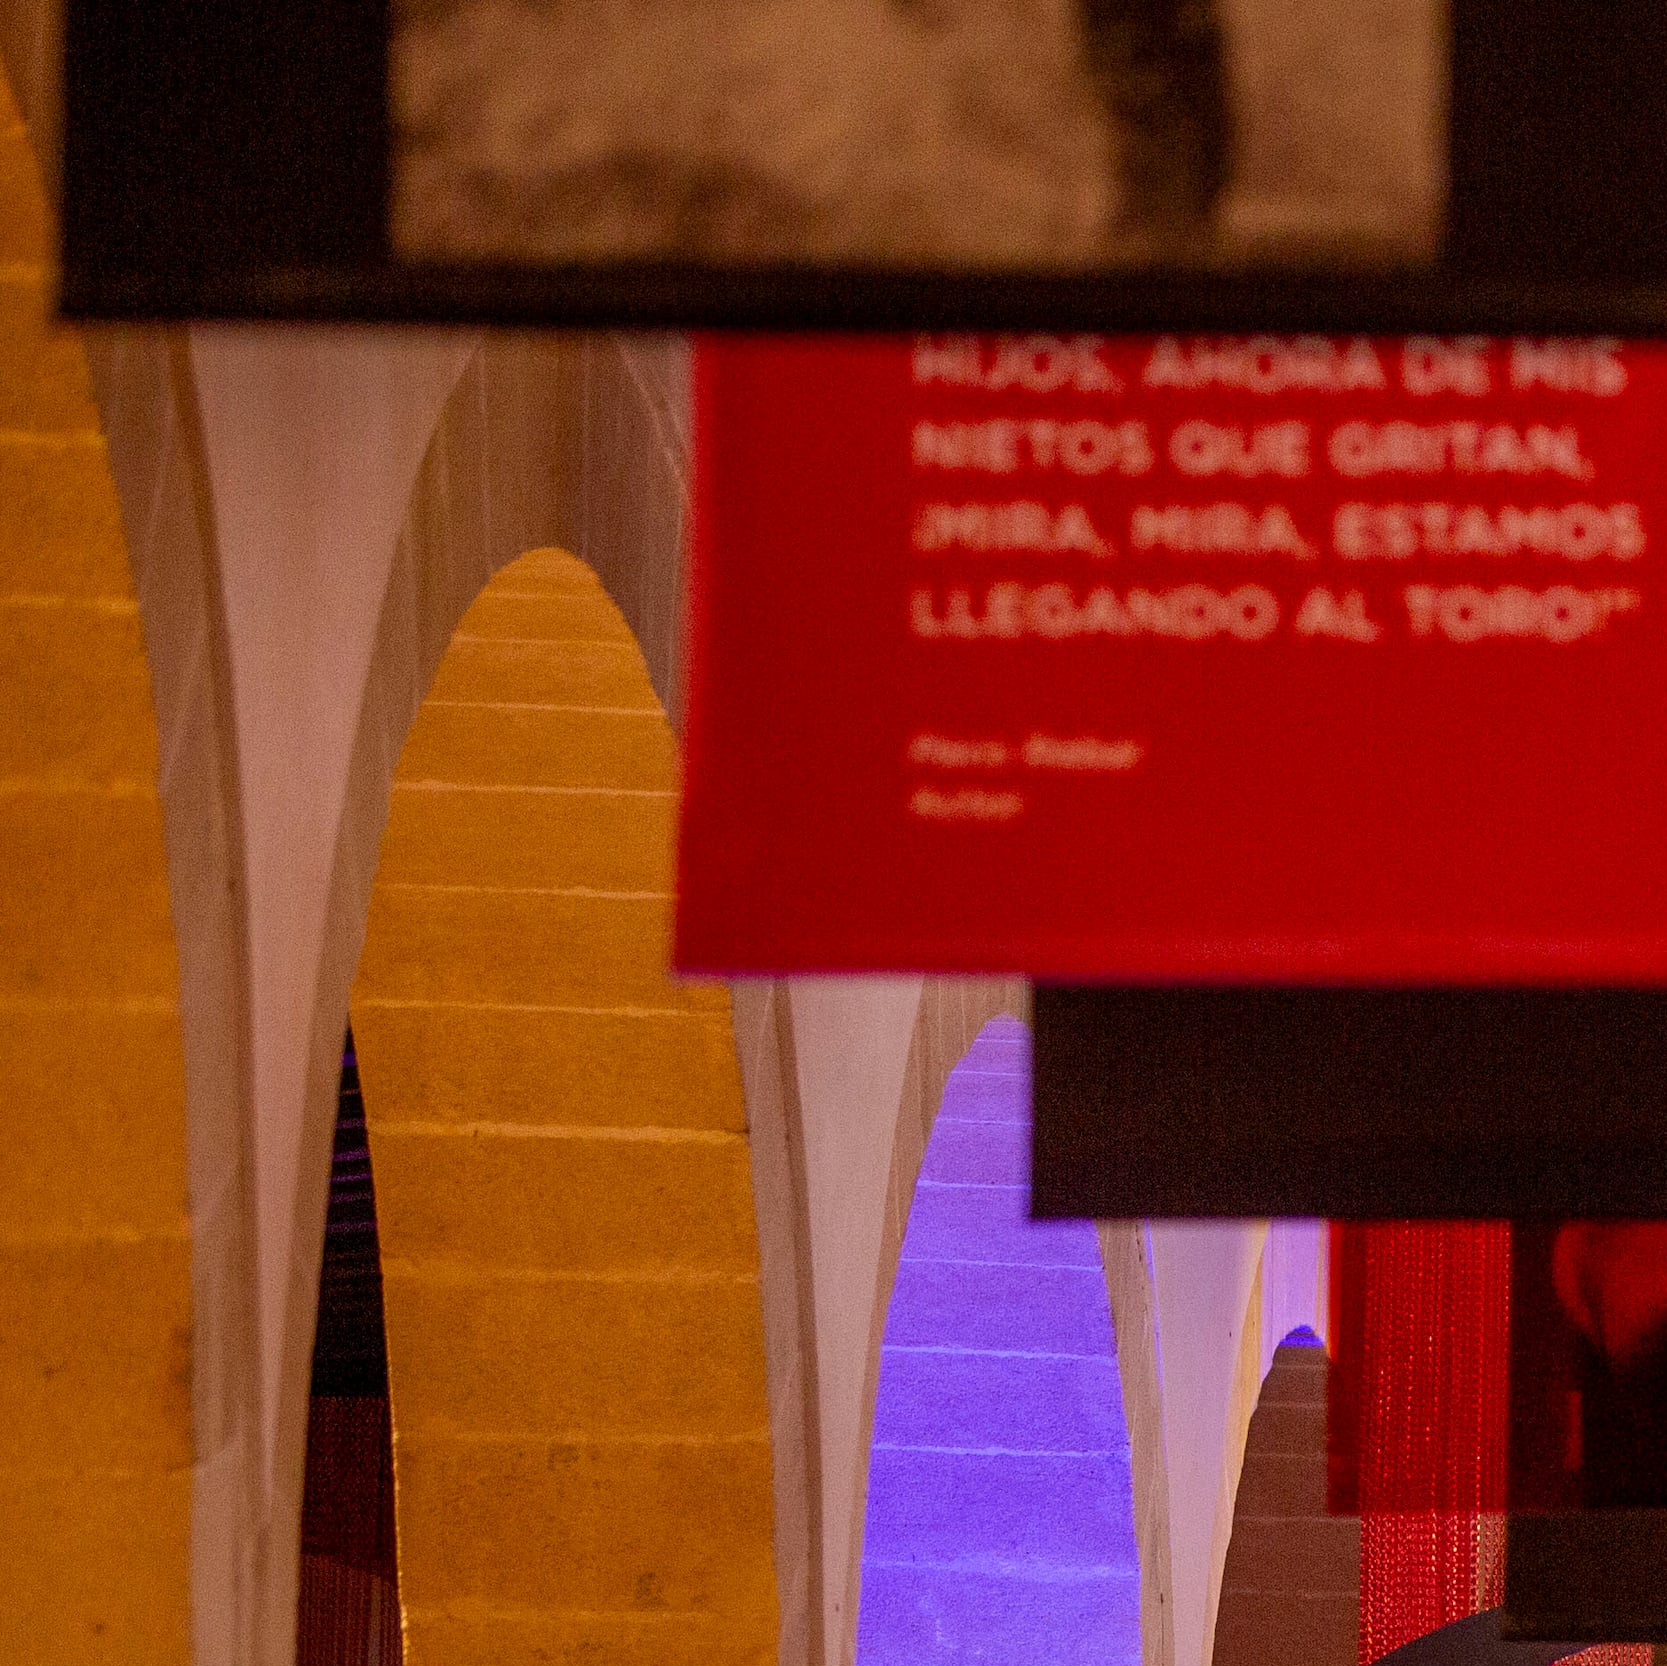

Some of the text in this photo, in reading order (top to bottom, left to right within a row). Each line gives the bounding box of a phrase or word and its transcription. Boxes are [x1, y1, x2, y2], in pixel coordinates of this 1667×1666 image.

[913, 421, 1595, 481] NIETOS QUE GRITAN,
[1333, 503, 1646, 560] ESTAMOS
[911, 583, 1280, 640] LLEGANDO
[1294, 586, 1382, 643] AL
